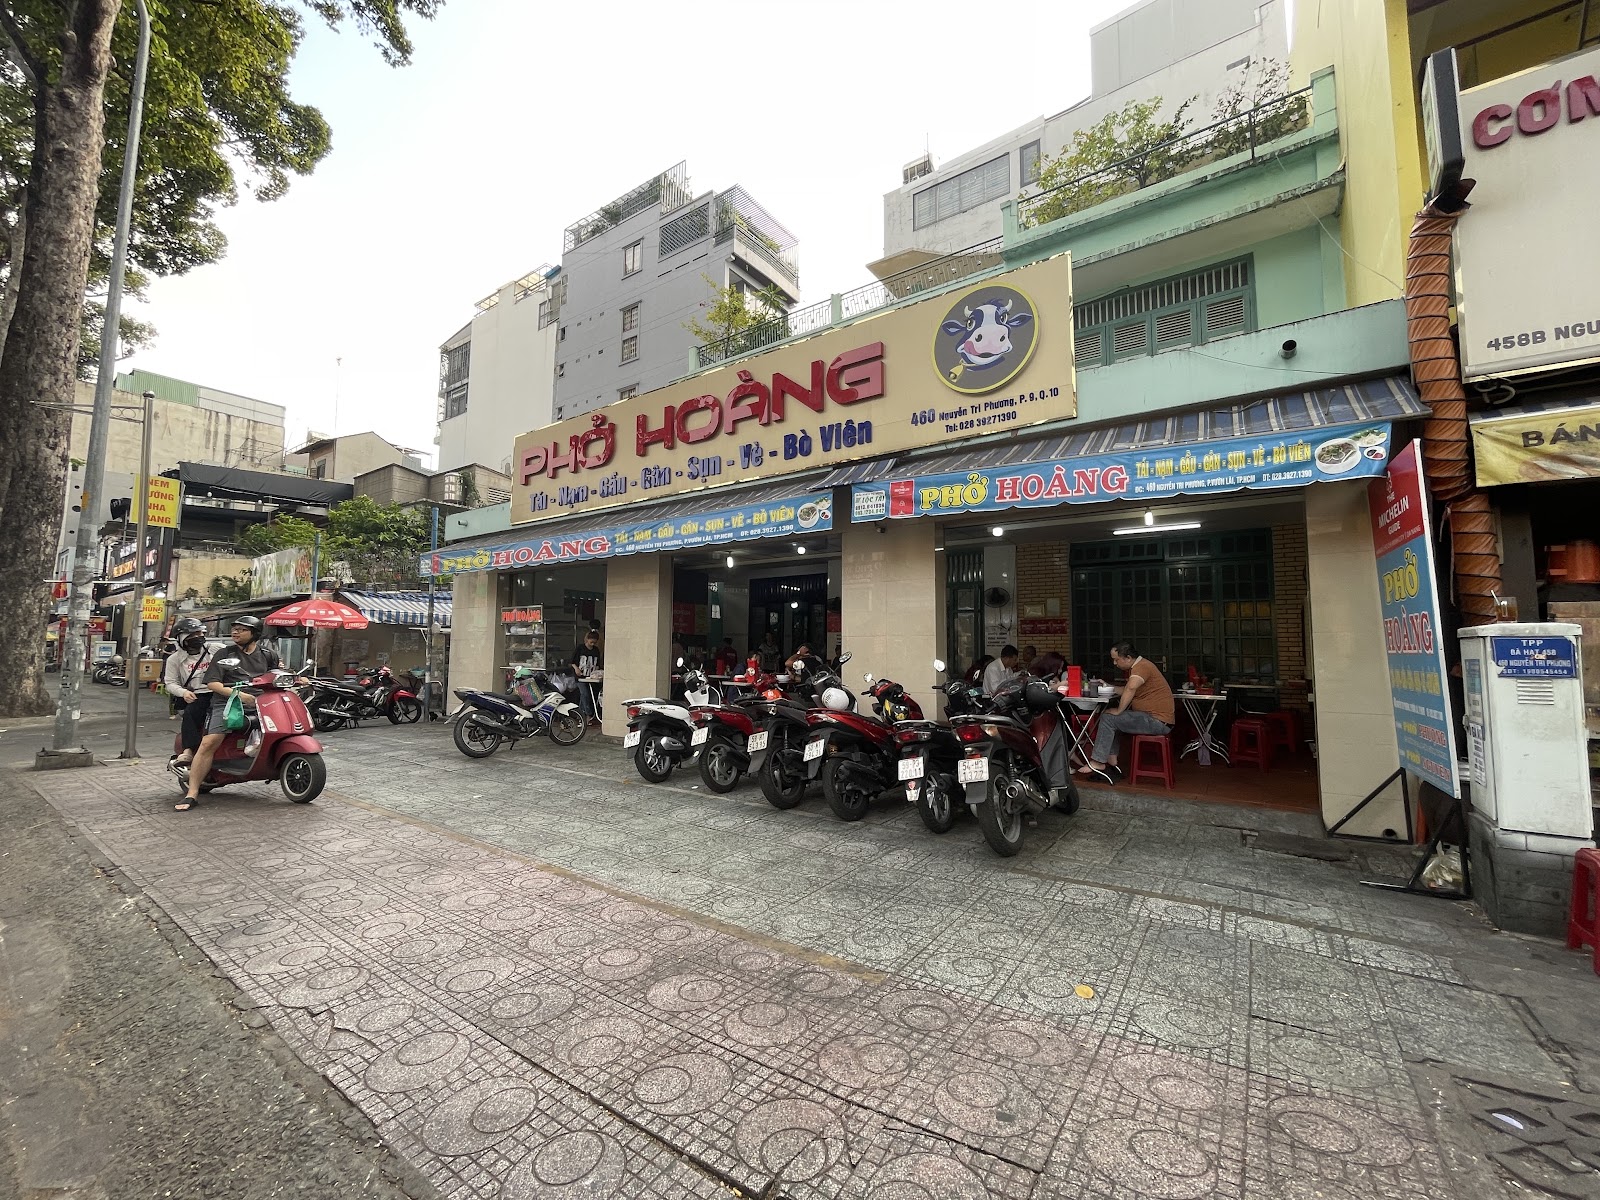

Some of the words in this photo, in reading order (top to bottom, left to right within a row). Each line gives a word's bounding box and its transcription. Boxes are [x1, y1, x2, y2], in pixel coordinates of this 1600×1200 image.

[1486, 330, 1547, 351] 458B
[519, 413, 616, 487] PHỞ
[635, 340, 886, 457] HOÀNG
[911, 408, 936, 427] 460
[959, 420, 974, 432] 028
[976, 410, 1017, 427] 39271390
[530, 491, 548, 512] Tái
[558, 484, 588, 508] Nạm
[687, 456, 721, 483] Sụn
[783, 429, 812, 460] Bò
[819, 419, 873, 452] Viên
[1136, 456, 1149, 479] TÁI
[1155, 458, 1174, 480] NẠM
[1227, 450, 1246, 472] SỤN
[1272, 440, 1287, 465] BÒ
[1287, 438, 1312, 463] VIÊN
[919, 473, 989, 510] PHỞ
[995, 464, 1129, 503] HOÀNG
[1386, 490, 1396, 503] THE
[704, 517, 725, 534] SỤN
[769, 504, 796, 523] VIÊN
[1378, 495, 1410, 529] MICHELIN
[442, 549, 491, 572] PHỞ
[491, 536, 612, 567] HOÀNG
[1382, 547, 1419, 606] PHỞ
[1384, 604, 1434, 654] HOÀNG
[1521, 639, 1544, 647] TPP
[1510, 647, 1522, 656] BÀ
